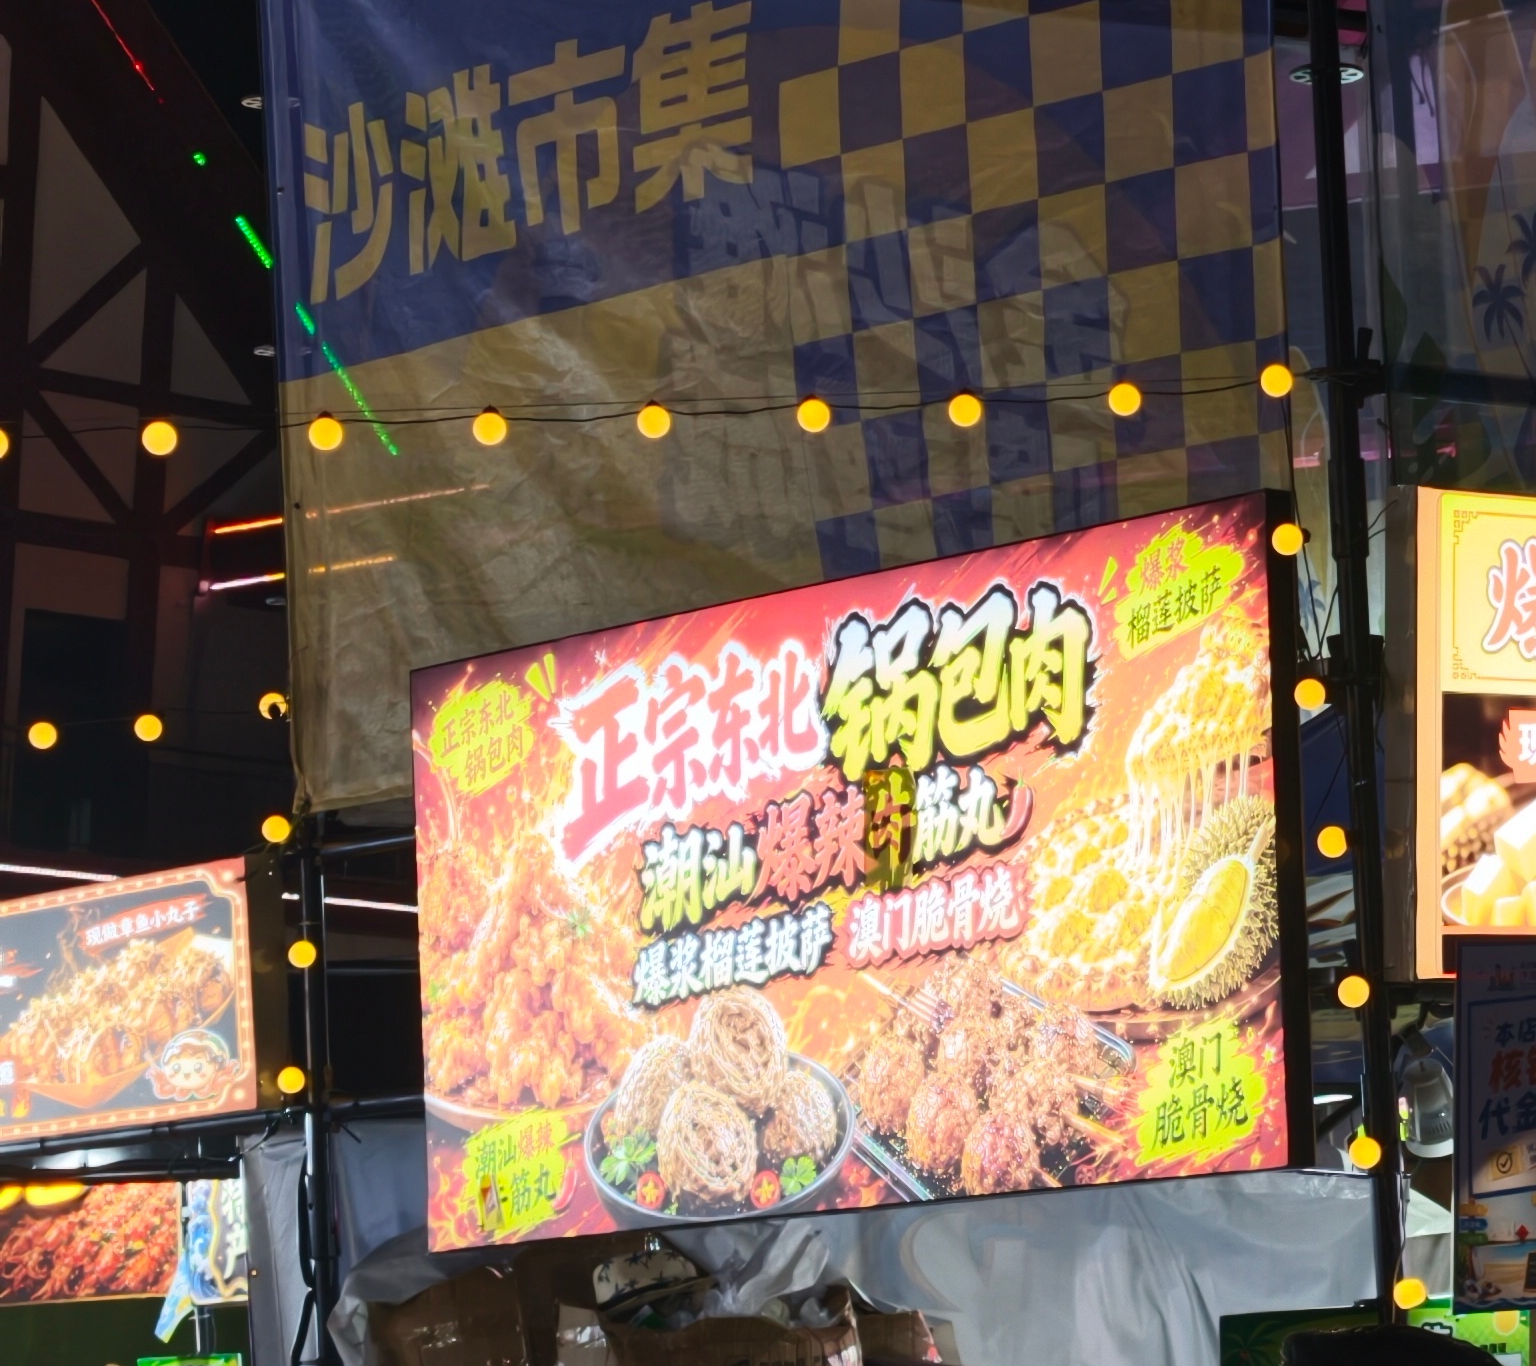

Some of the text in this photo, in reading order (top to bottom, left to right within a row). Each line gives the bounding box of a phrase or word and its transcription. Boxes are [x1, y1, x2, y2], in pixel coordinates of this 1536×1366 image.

[303, 0, 753, 305] 沙滩市集
[1126, 565, 1222, 650] 榴莲披萨
[441, 690, 514, 758] 正宗东北
[465, 724, 524, 787] 锅包肉
[634, 866, 1019, 1006] 爆浆榴莲披萨 澳门脆骨烧
[1169, 1032, 1221, 1088] 澳门
[1151, 1076, 1248, 1152] 脆骨烧
